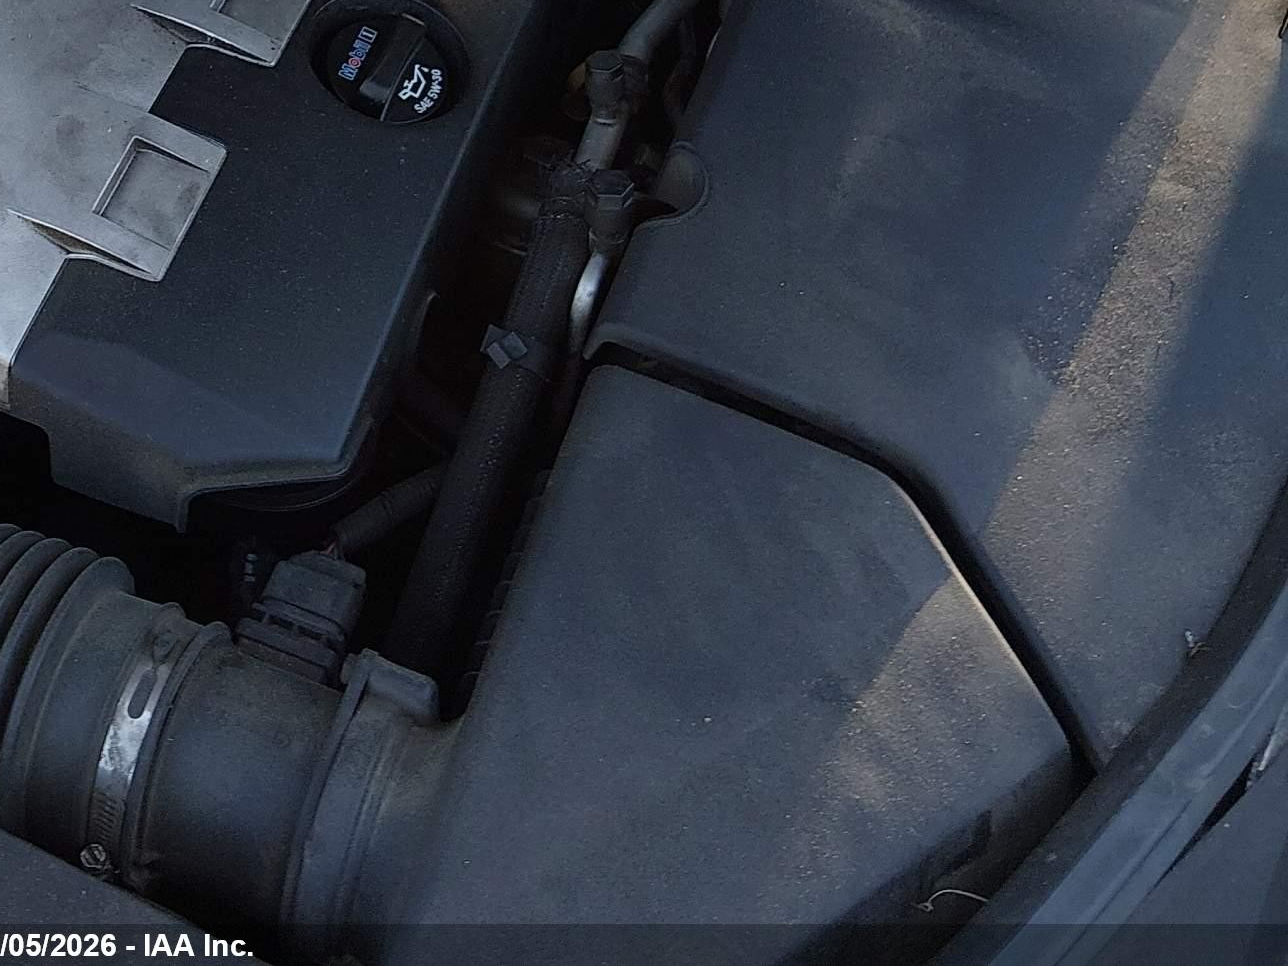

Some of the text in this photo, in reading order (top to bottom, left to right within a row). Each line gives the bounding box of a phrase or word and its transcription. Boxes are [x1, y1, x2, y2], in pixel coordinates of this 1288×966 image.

[338, 26, 379, 81] Mobil 1
[413, 68, 443, 114] SAE 5W-30
